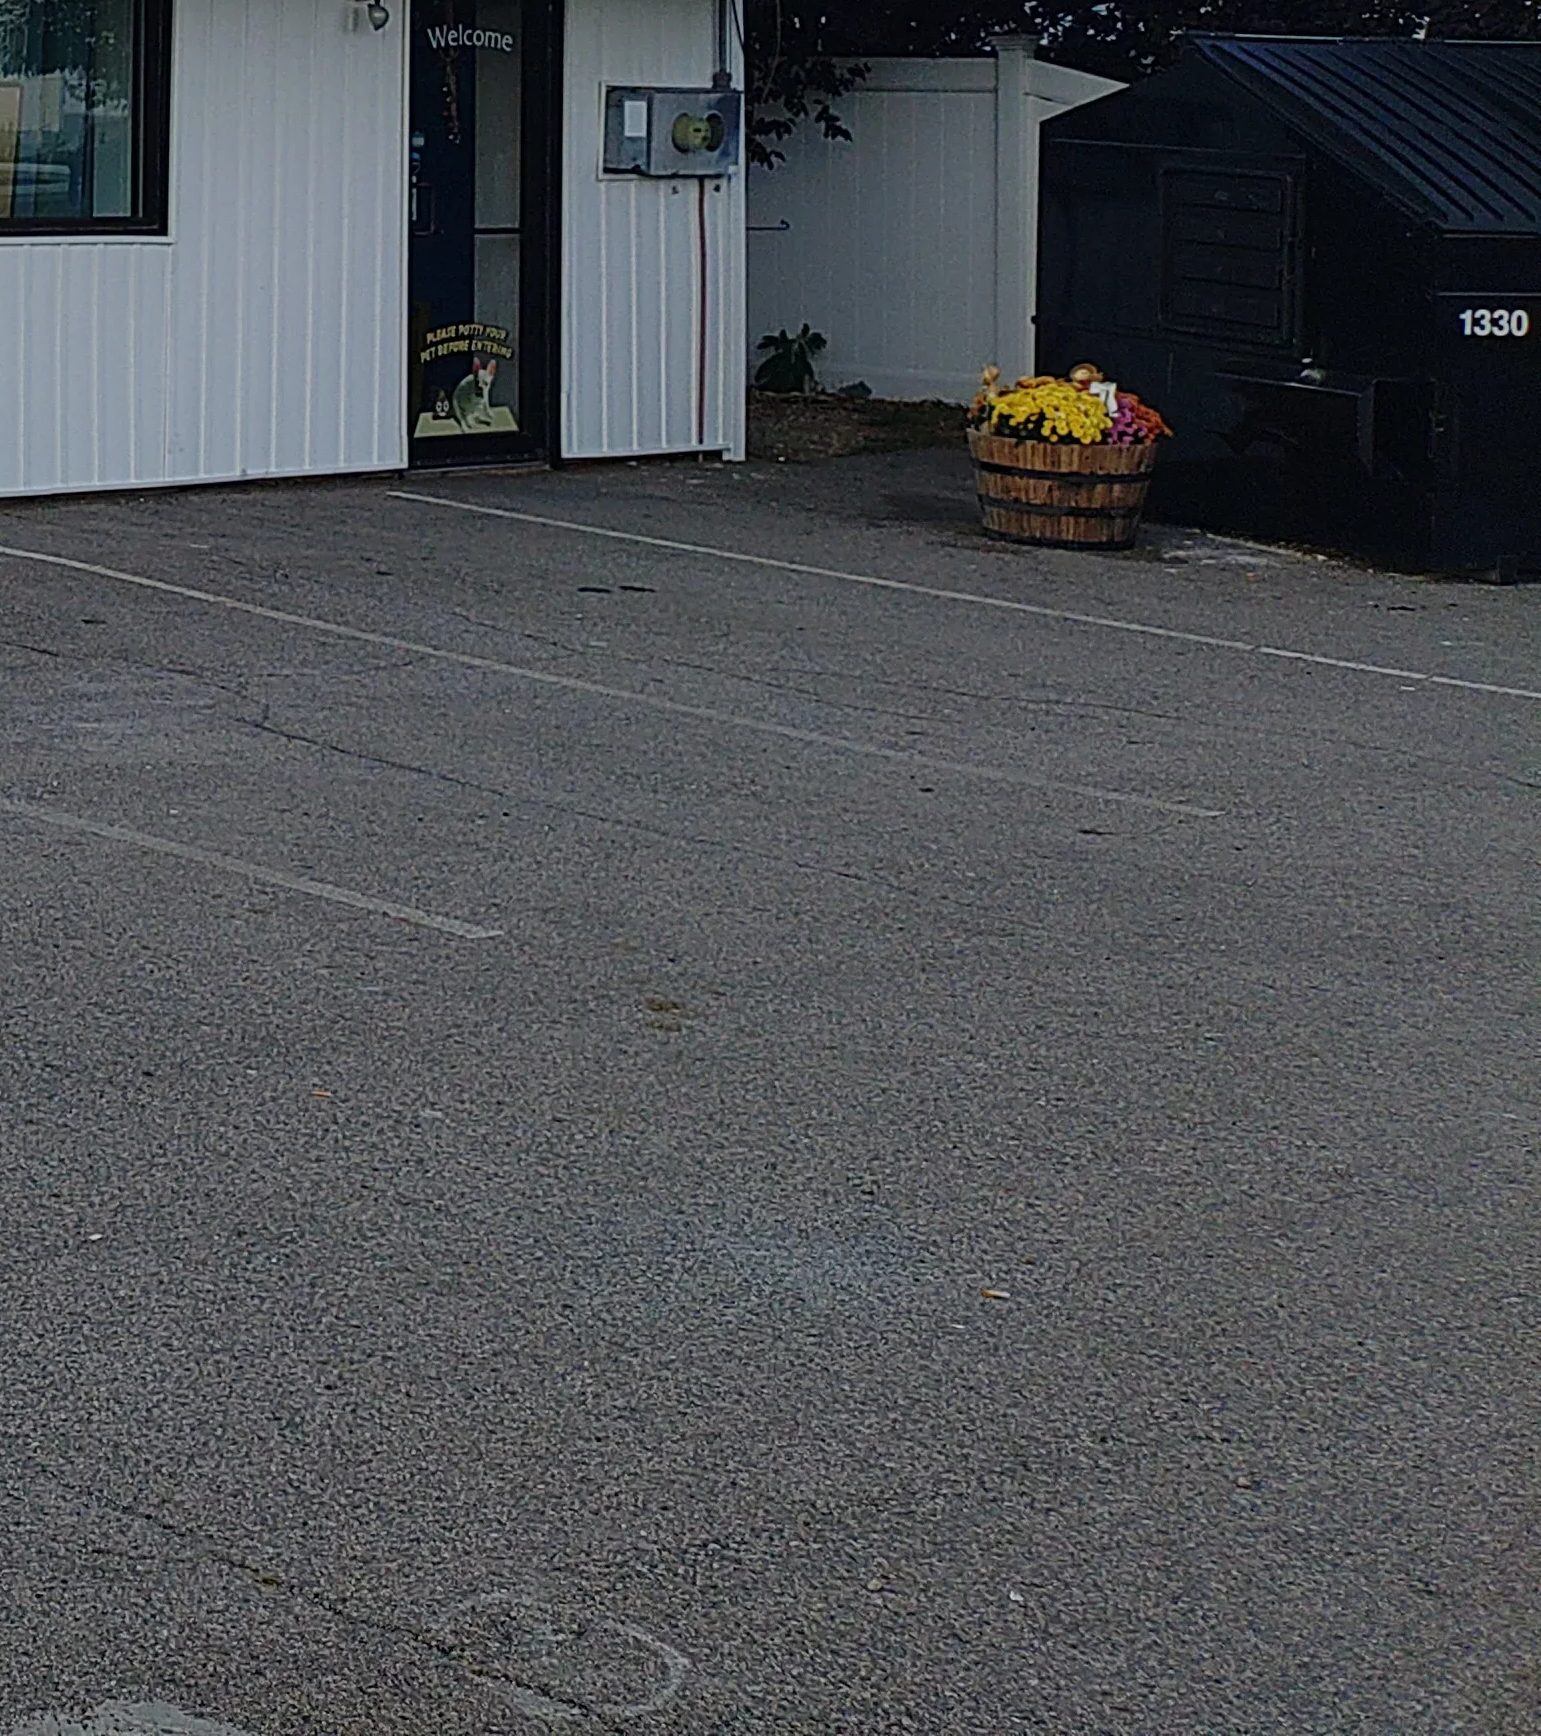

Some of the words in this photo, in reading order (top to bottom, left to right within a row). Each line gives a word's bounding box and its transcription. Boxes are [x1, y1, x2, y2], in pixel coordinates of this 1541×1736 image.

[427, 24, 513, 52] Welcome
[426, 325, 456, 345] PLEASE
[458, 323, 483, 336] POTTY
[485, 326, 506, 340] YOUR
[1458, 309, 1529, 337] 1330
[420, 346, 436, 363] PET
[437, 339, 470, 356] BEFORE
[471, 339, 513, 359] ENTERING
